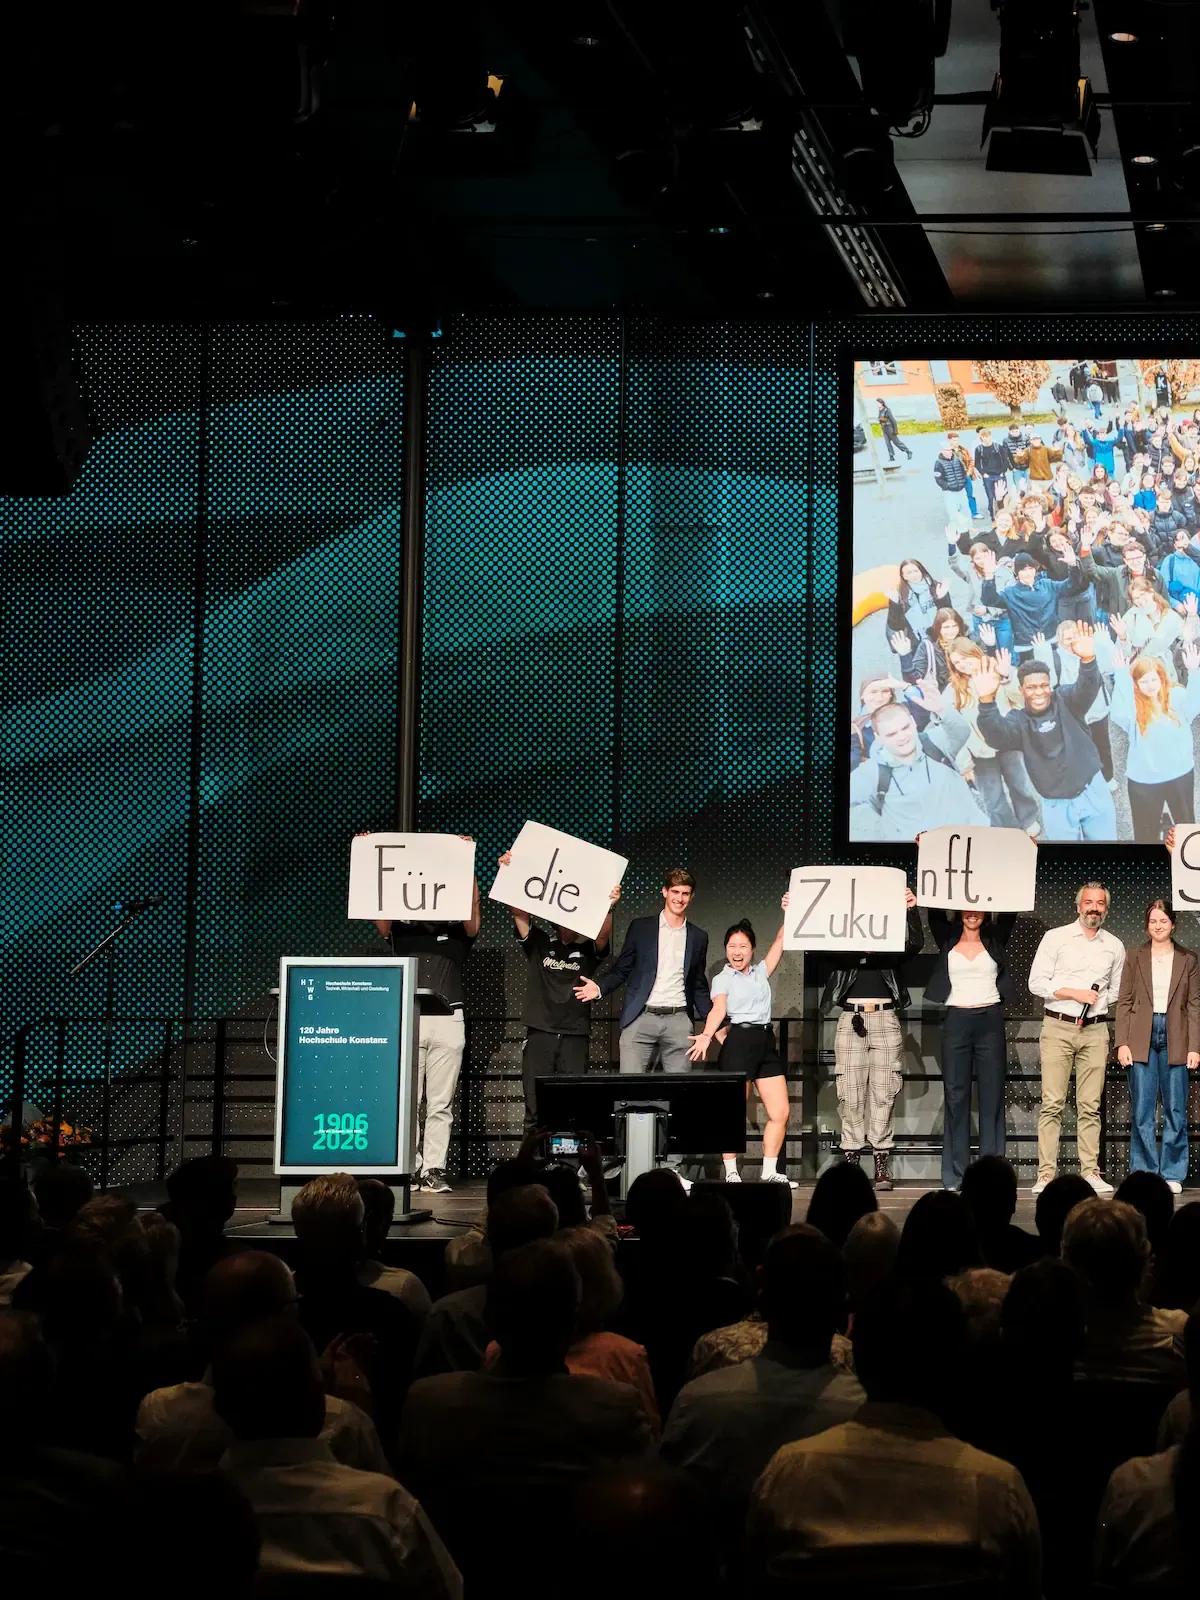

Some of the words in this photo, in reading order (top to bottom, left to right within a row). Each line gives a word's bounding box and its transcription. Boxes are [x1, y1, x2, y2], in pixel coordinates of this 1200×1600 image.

[374, 844, 447, 912] Für
[523, 847, 580, 913] die
[921, 833, 993, 904] nft.
[793, 878, 889, 940] Zuku
[299, 1036, 347, 1044] Hochschule
[349, 1036, 388, 1044] Konstanz
[312, 1130, 368, 1150] 2026
[313, 1113, 368, 1134] 1906
